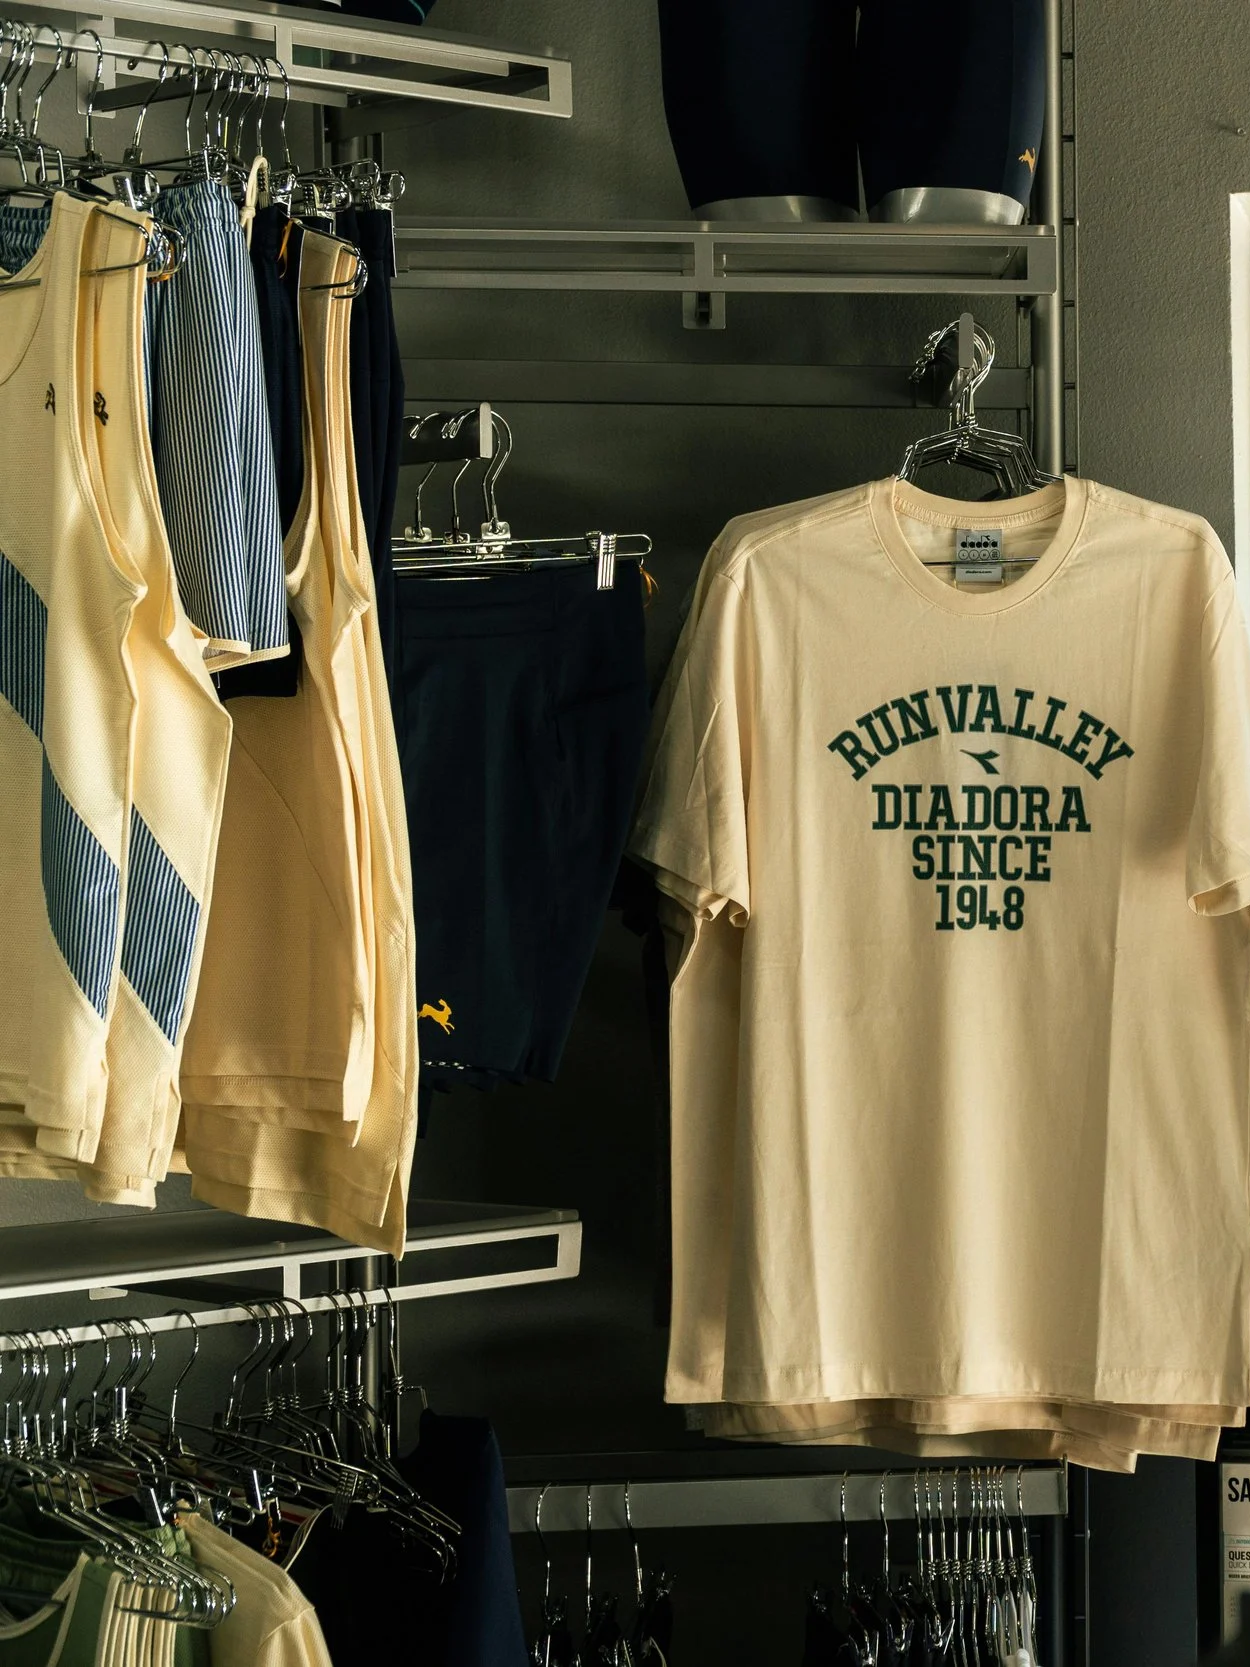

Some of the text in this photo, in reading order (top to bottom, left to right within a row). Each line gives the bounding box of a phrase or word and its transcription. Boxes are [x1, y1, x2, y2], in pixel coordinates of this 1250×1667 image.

[872, 783, 1091, 832] DIADORA
[912, 834, 1052, 882] SINCE
[935, 883, 1025, 931] 1948
[1228, 1561, 1247, 1569] QUICK
